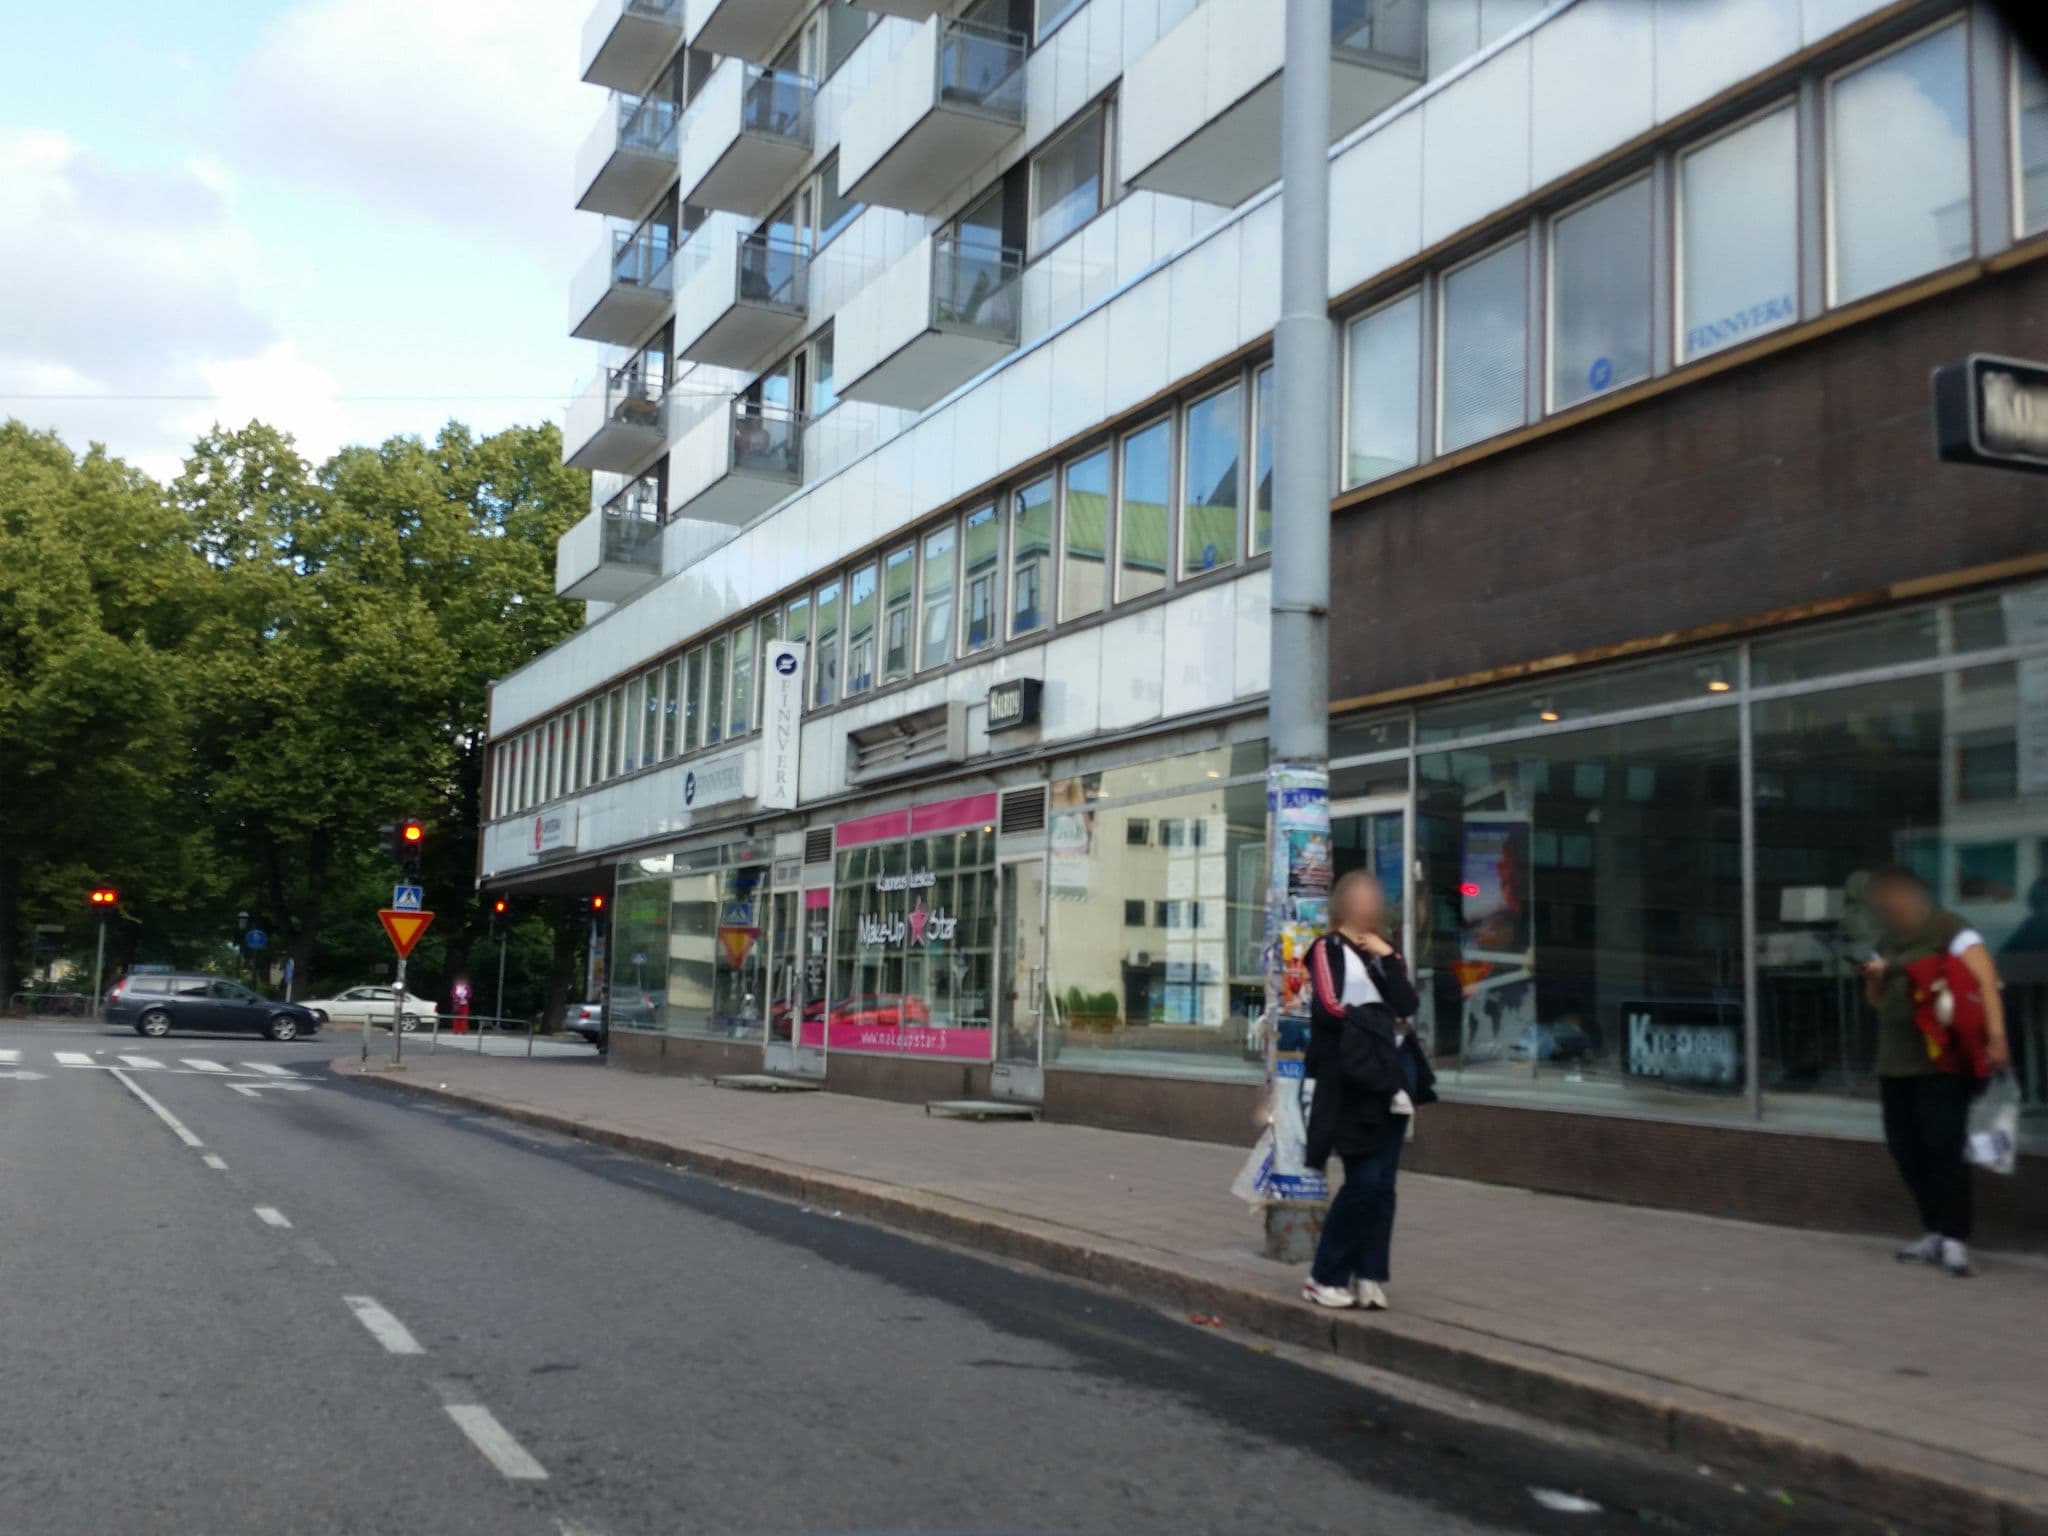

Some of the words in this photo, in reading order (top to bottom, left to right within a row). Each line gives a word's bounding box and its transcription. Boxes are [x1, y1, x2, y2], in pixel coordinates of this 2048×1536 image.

[1686, 294, 1794, 354] FINNVERA
[775, 678, 791, 801] FINNVERA
[927, 906, 958, 940] Star
